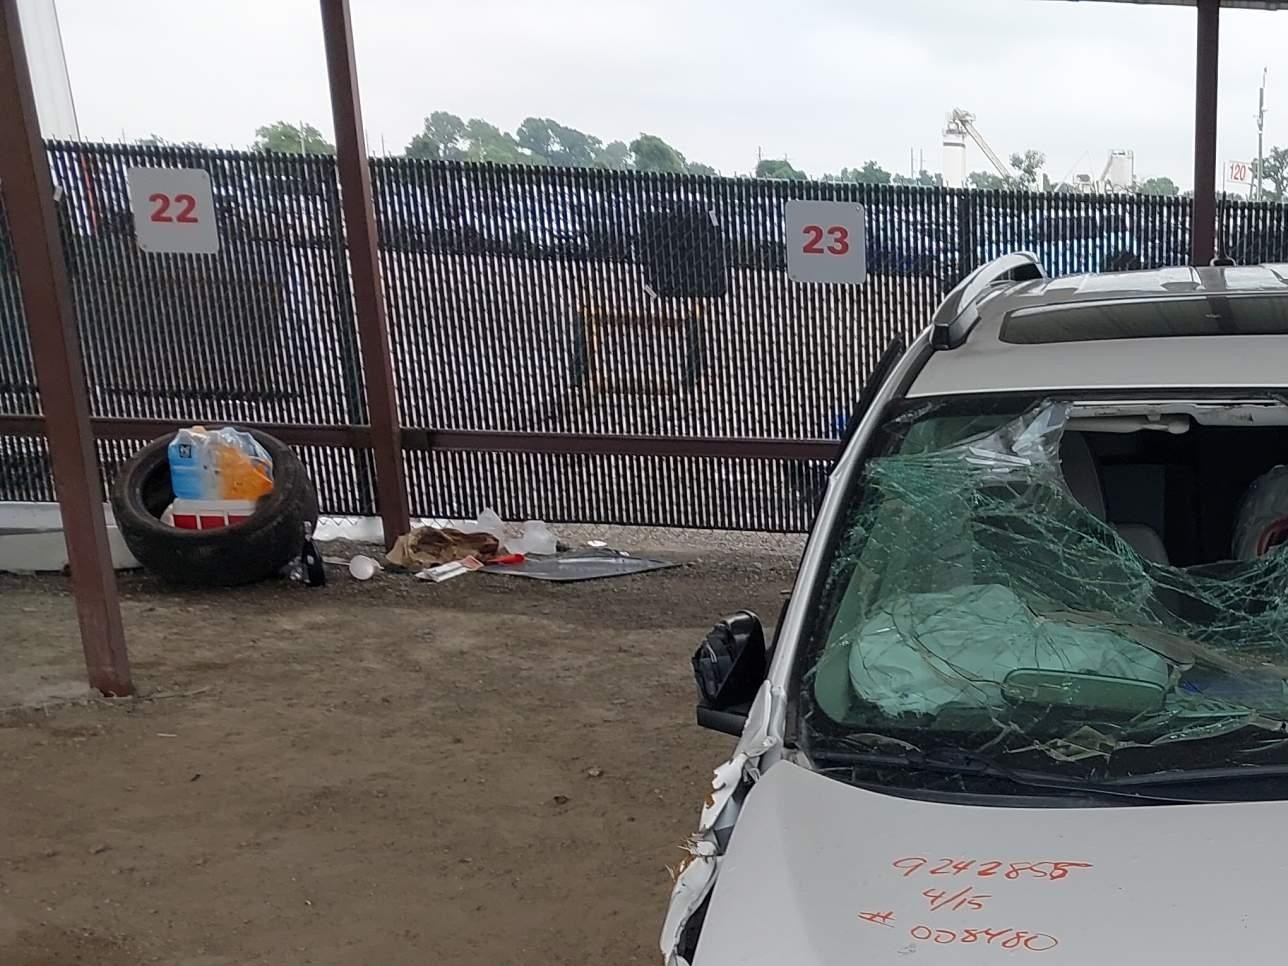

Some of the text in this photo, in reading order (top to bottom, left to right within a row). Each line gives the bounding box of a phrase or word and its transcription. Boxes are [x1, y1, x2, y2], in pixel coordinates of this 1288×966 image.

[149, 193, 199, 224] 22
[802, 225, 849, 256] 23
[922, 886, 993, 912] 4/15
